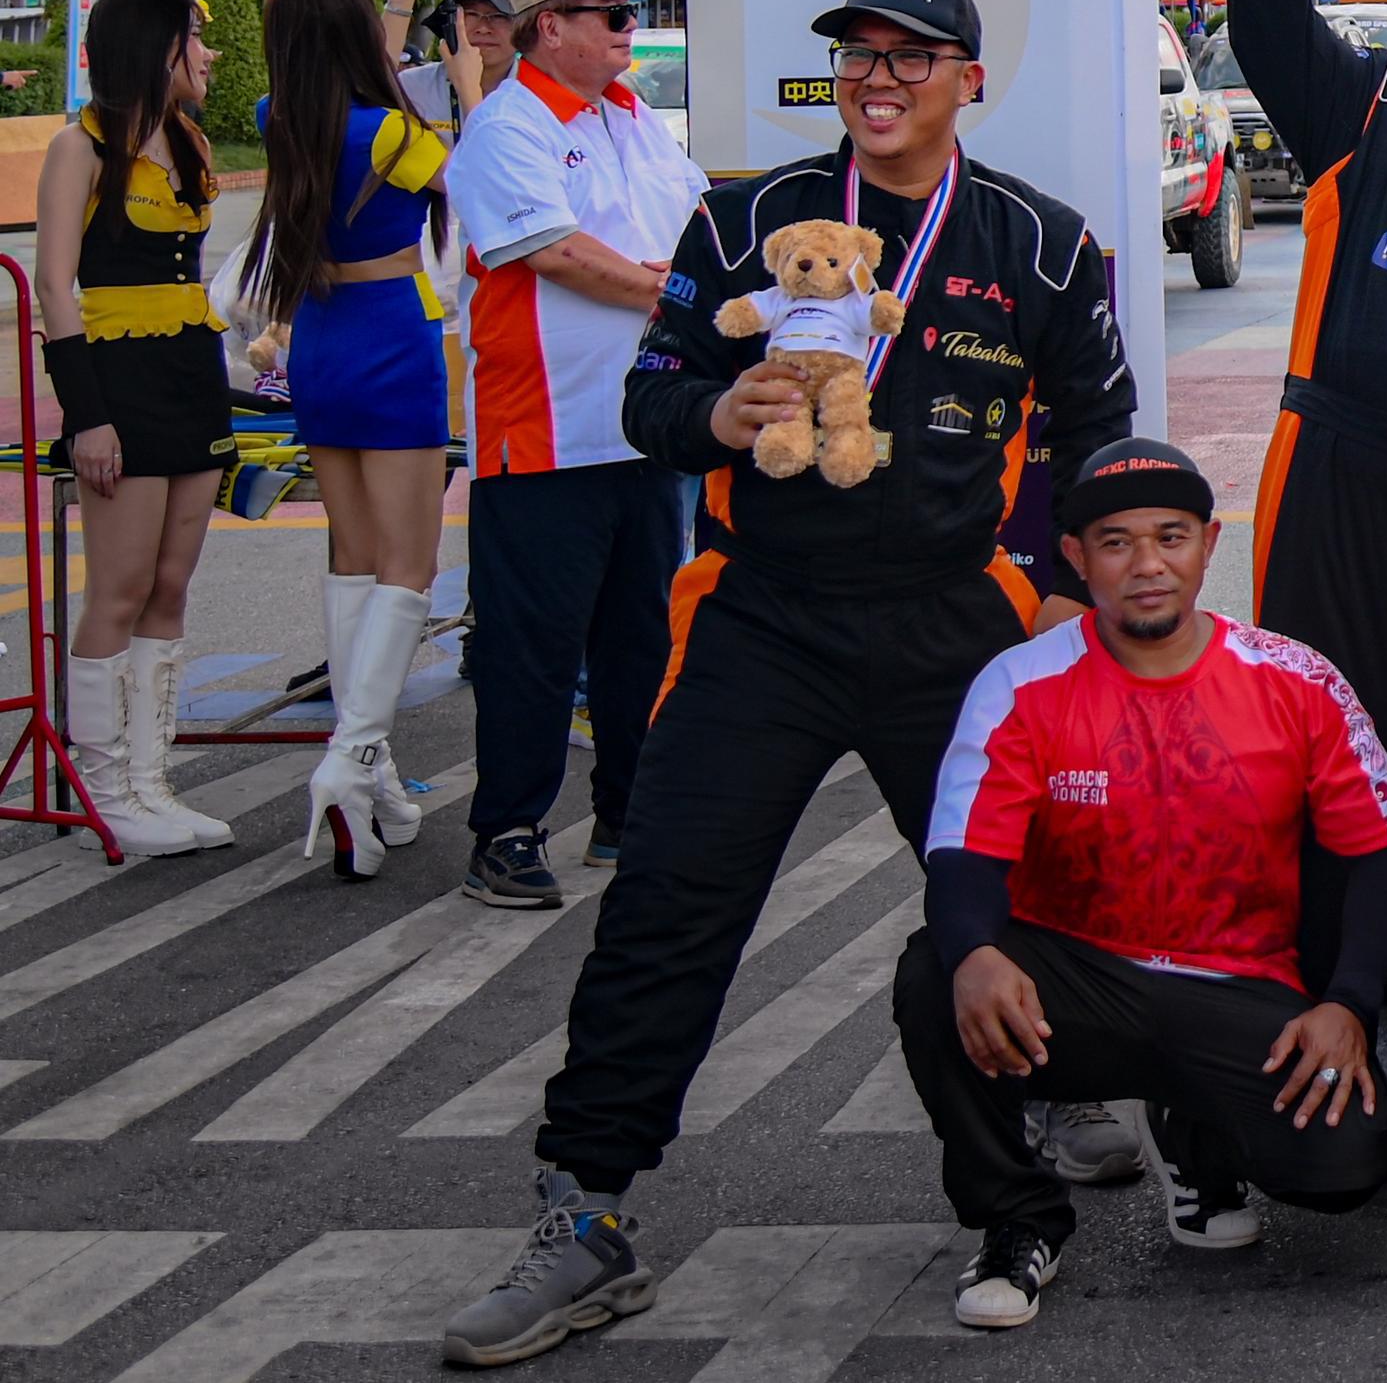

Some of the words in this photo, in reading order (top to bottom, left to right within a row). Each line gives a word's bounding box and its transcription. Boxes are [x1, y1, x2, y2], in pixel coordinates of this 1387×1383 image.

[126, 194, 162, 208] ROPAK
[506, 205, 538, 224] ISHIDA
[940, 330, 1025, 370] Takatran
